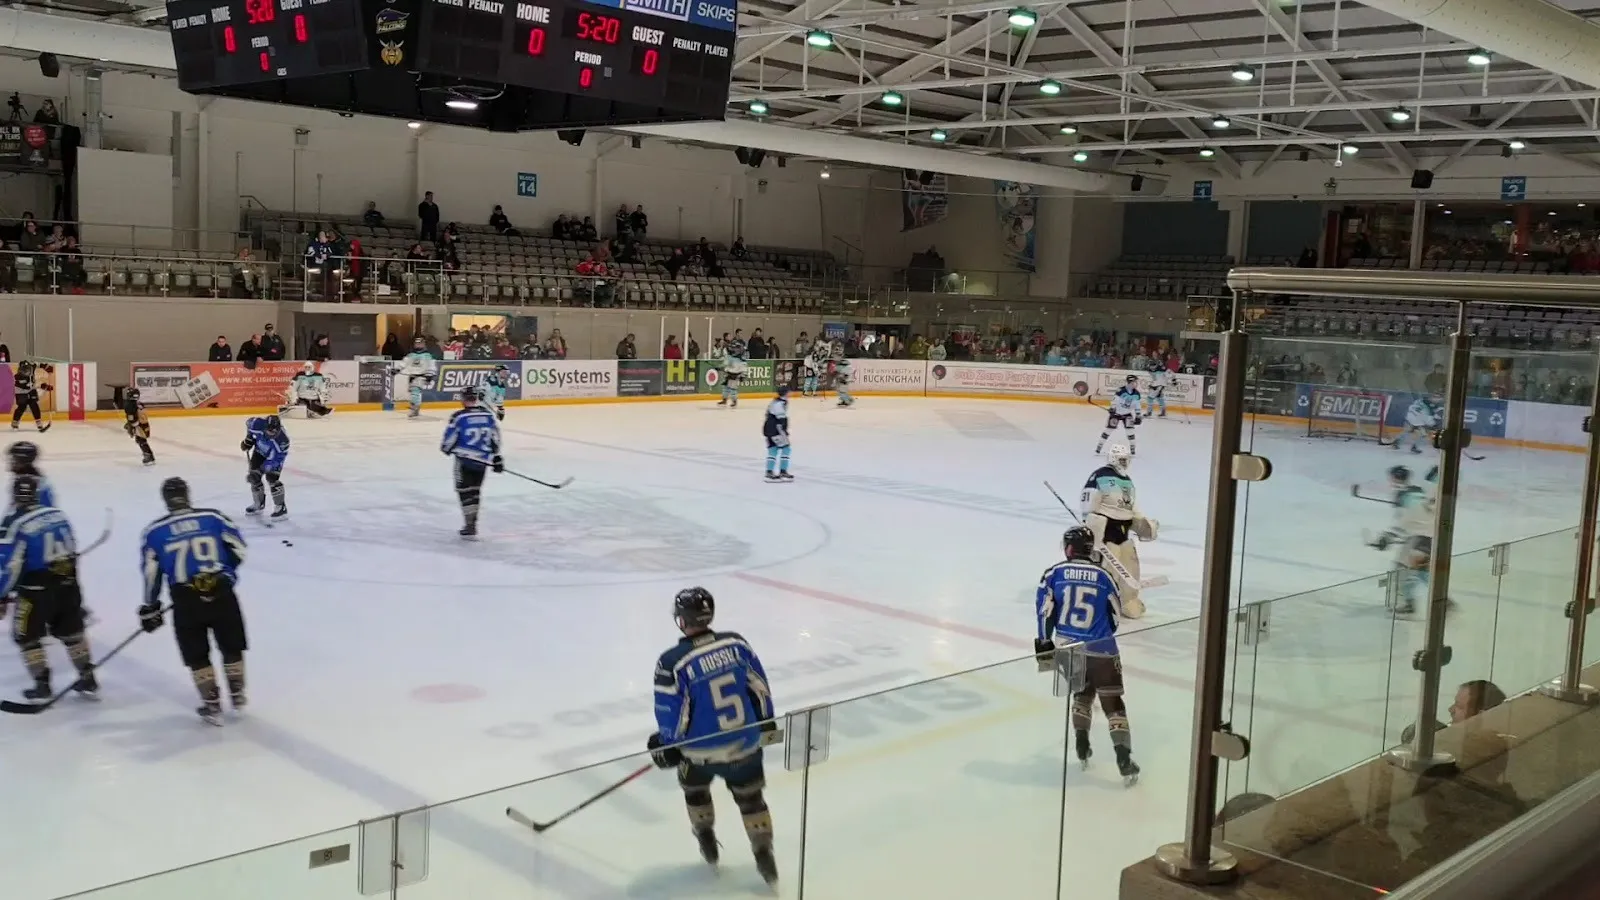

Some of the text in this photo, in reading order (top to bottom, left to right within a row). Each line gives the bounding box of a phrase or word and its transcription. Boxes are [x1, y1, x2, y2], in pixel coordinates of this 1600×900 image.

[211, 6, 231, 23] HOME
[468, 0, 504, 14] PENALTY
[517, 5, 550, 25] HOME
[627, 0, 736, 22] ITH SKIPS
[577, 13, 620, 43] 5:20
[632, 26, 665, 45] GUEST
[251, 36, 269, 48] PERIOD
[528, 28, 544, 54] 0
[673, 37, 729, 57] PENALTY PLAYER
[575, 51, 601, 65] PERIOD
[643, 49, 658, 75] 0
[580, 68, 592, 87] 0
[520, 181, 535, 194] 14
[1508, 185, 1519, 196] 2
[71, 366, 81, 408] CCM
[443, 370, 491, 386] SMIT
[527, 368, 611, 388] OSSystems
[863, 375, 921, 383] BUCKINGHAM
[1005, 370, 1035, 384] Party
[1037, 372, 1070, 385] Night
[1319, 395, 1383, 416] SMITH
[1081, 492, 1090, 502] 31
[163, 536, 222, 584] 79
[1063, 568, 1098, 581] GRIFFIN
[1059, 585, 1098, 629] 15
[709, 673, 745, 731] 5
